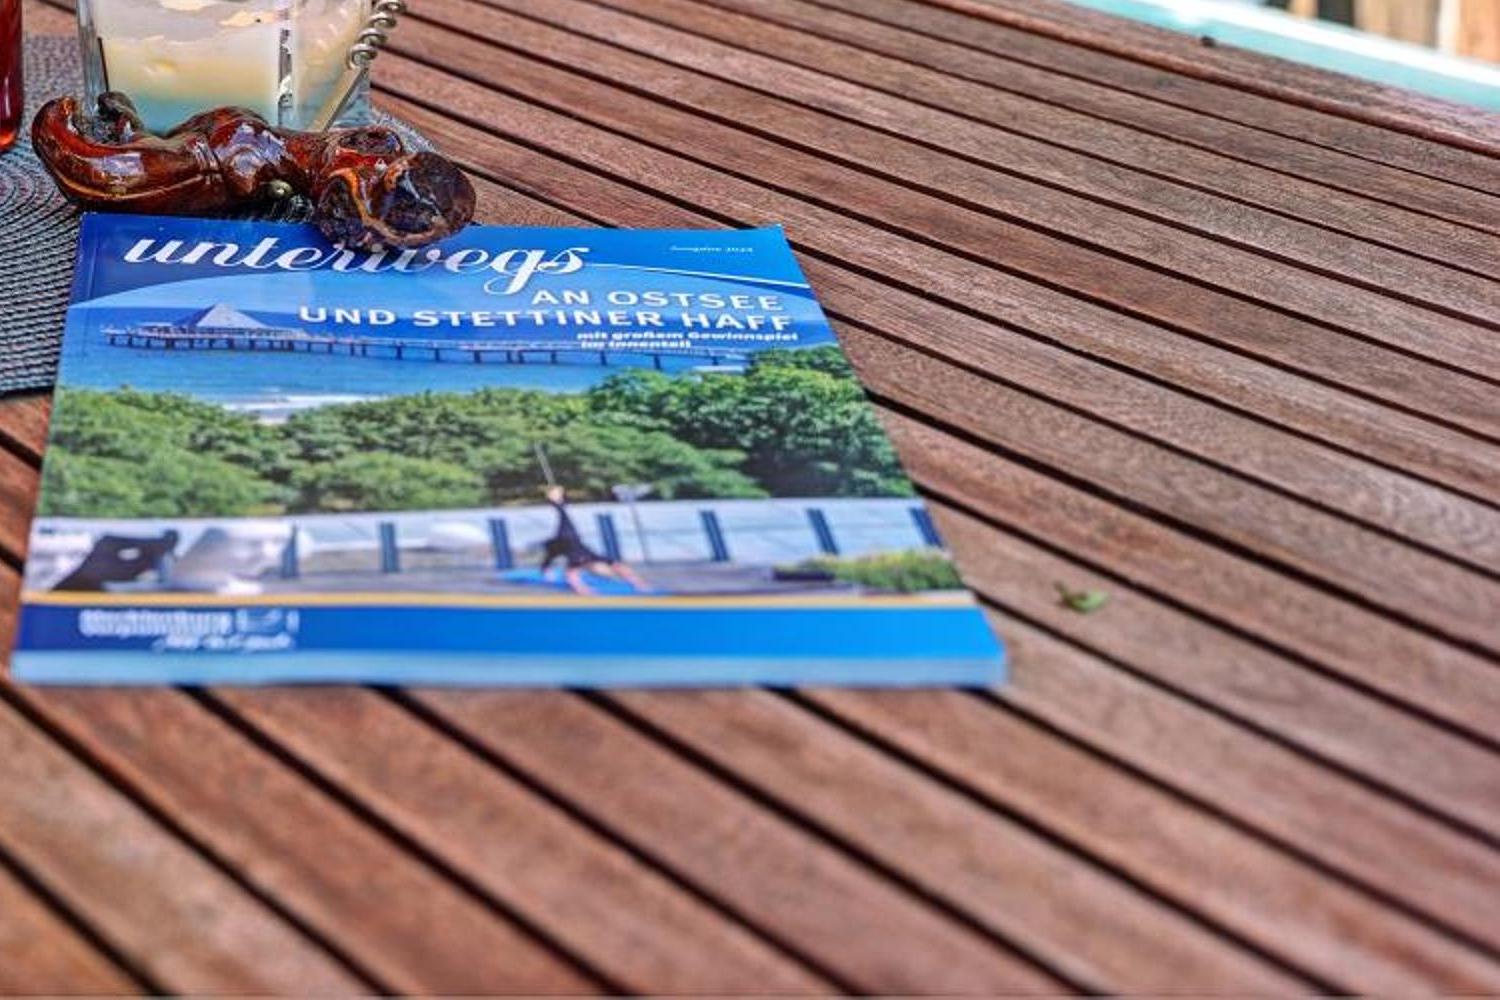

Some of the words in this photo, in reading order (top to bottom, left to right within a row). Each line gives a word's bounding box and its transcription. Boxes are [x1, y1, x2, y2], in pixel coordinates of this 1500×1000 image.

[123, 236, 590, 296] unterwegs
[531, 289, 589, 306] AN
[607, 290, 784, 311] OSTSEE
[300, 306, 395, 326] UND
[413, 309, 665, 327] STETTINER
[681, 313, 793, 331] HAFF
